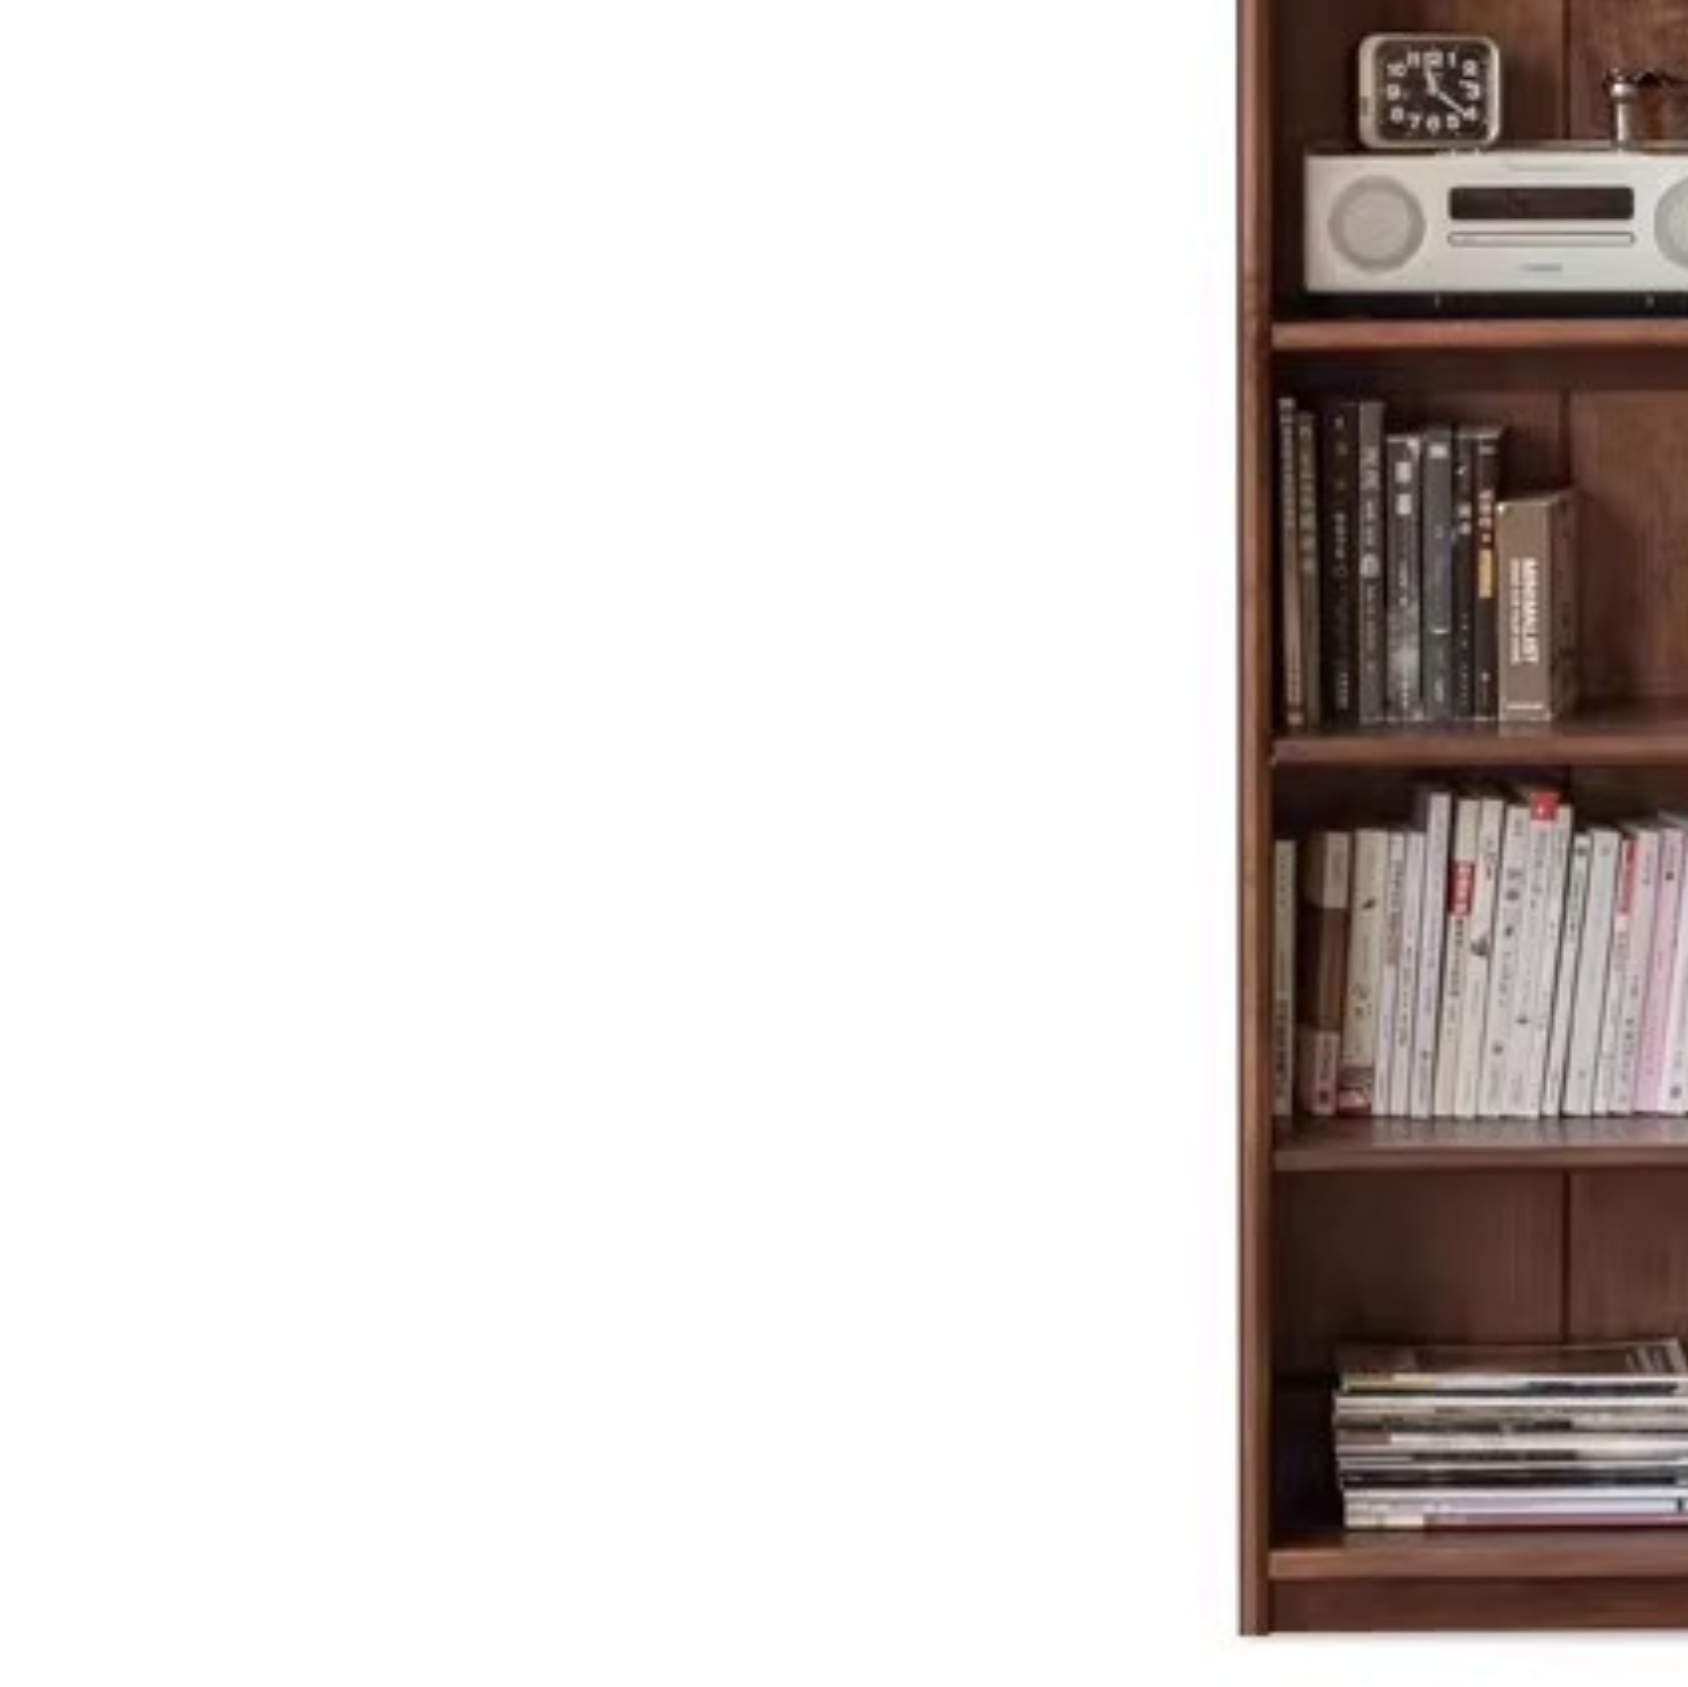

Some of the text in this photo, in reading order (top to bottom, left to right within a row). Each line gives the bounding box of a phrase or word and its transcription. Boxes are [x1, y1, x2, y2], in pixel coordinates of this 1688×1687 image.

[1446, 51, 1457, 69] 1
[1462, 59, 1477, 78] 2
[1386, 61, 1408, 79] 10
[1386, 84, 1401, 102] 9
[1458, 79, 1481, 101] 3
[1390, 106, 1405, 125] 8
[1404, 112, 1421, 130] 7
[1426, 114, 1441, 133] 6
[1446, 114, 1460, 130] 5
